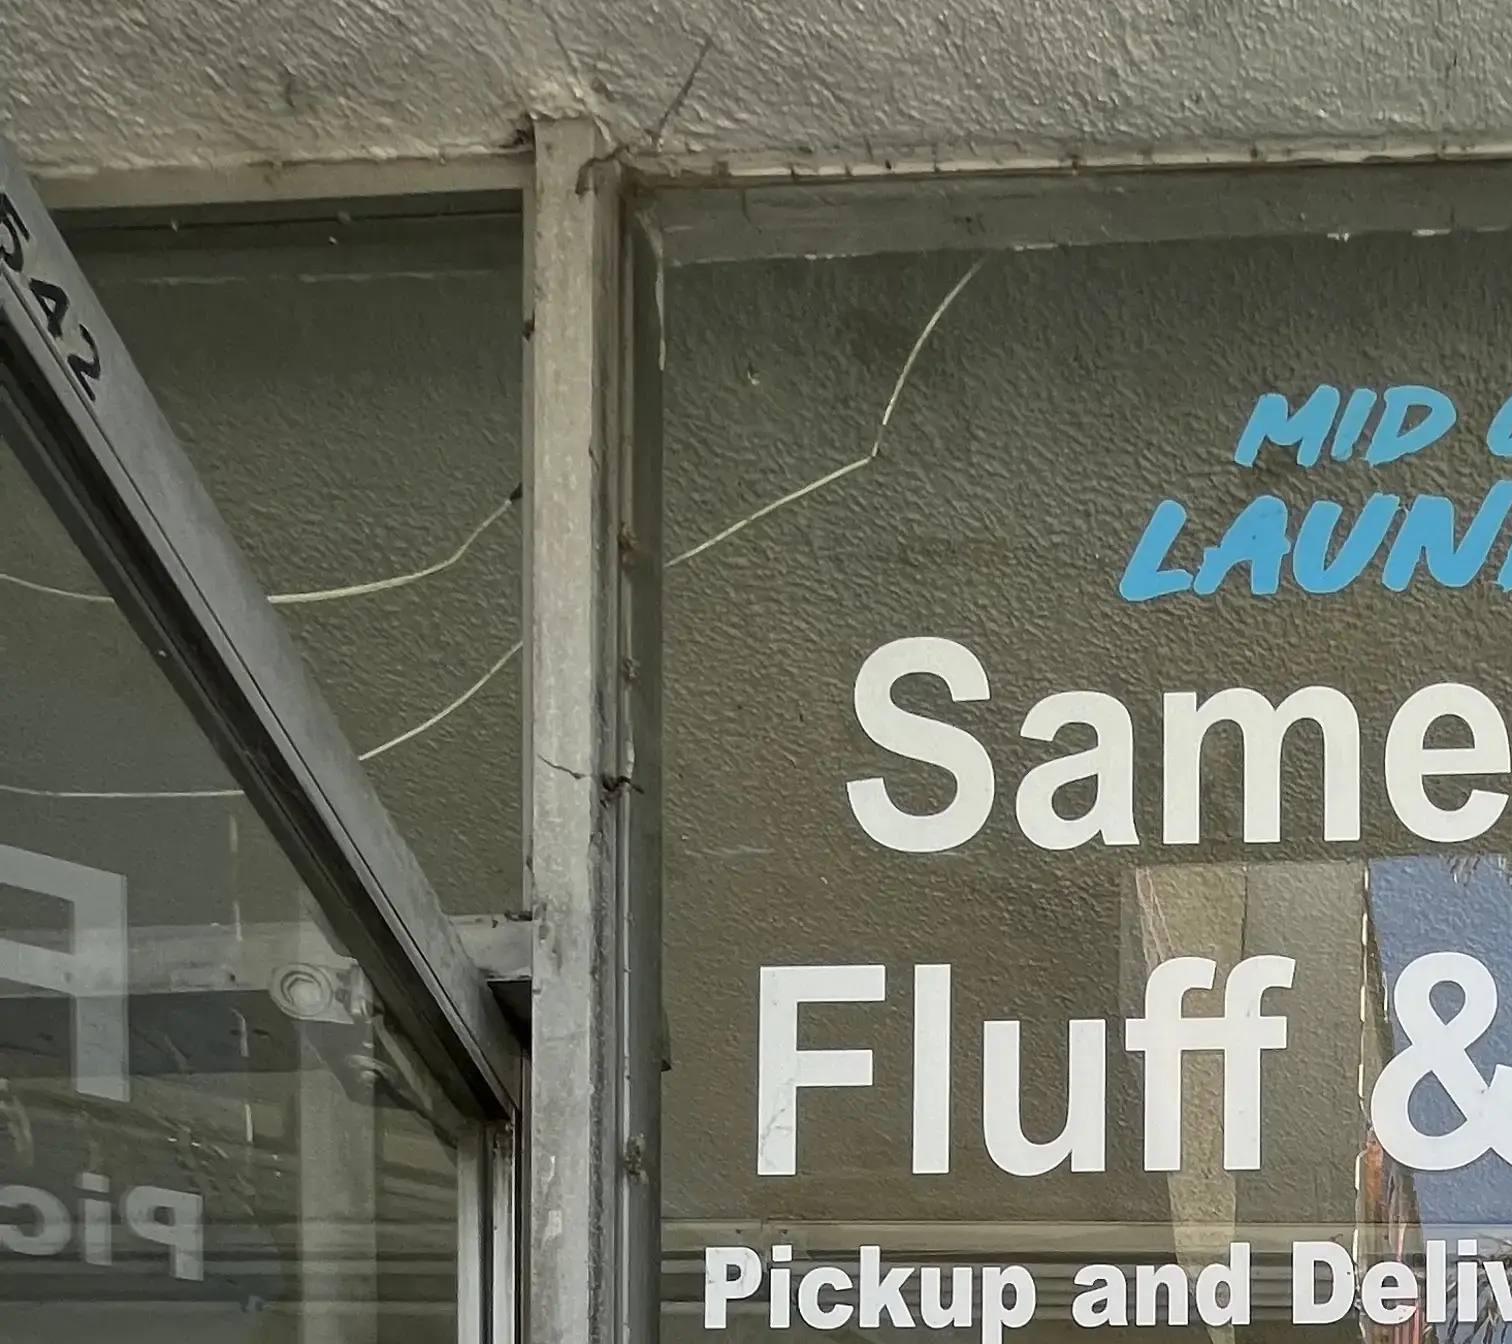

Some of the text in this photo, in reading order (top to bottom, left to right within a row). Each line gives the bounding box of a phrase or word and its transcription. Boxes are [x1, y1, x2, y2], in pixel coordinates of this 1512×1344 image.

[1233, 383, 1457, 468] MID
[846, 635, 1512, 854] Same
[756, 954, 1296, 1177] Fluff
[1071, 1241, 1252, 1330] and
